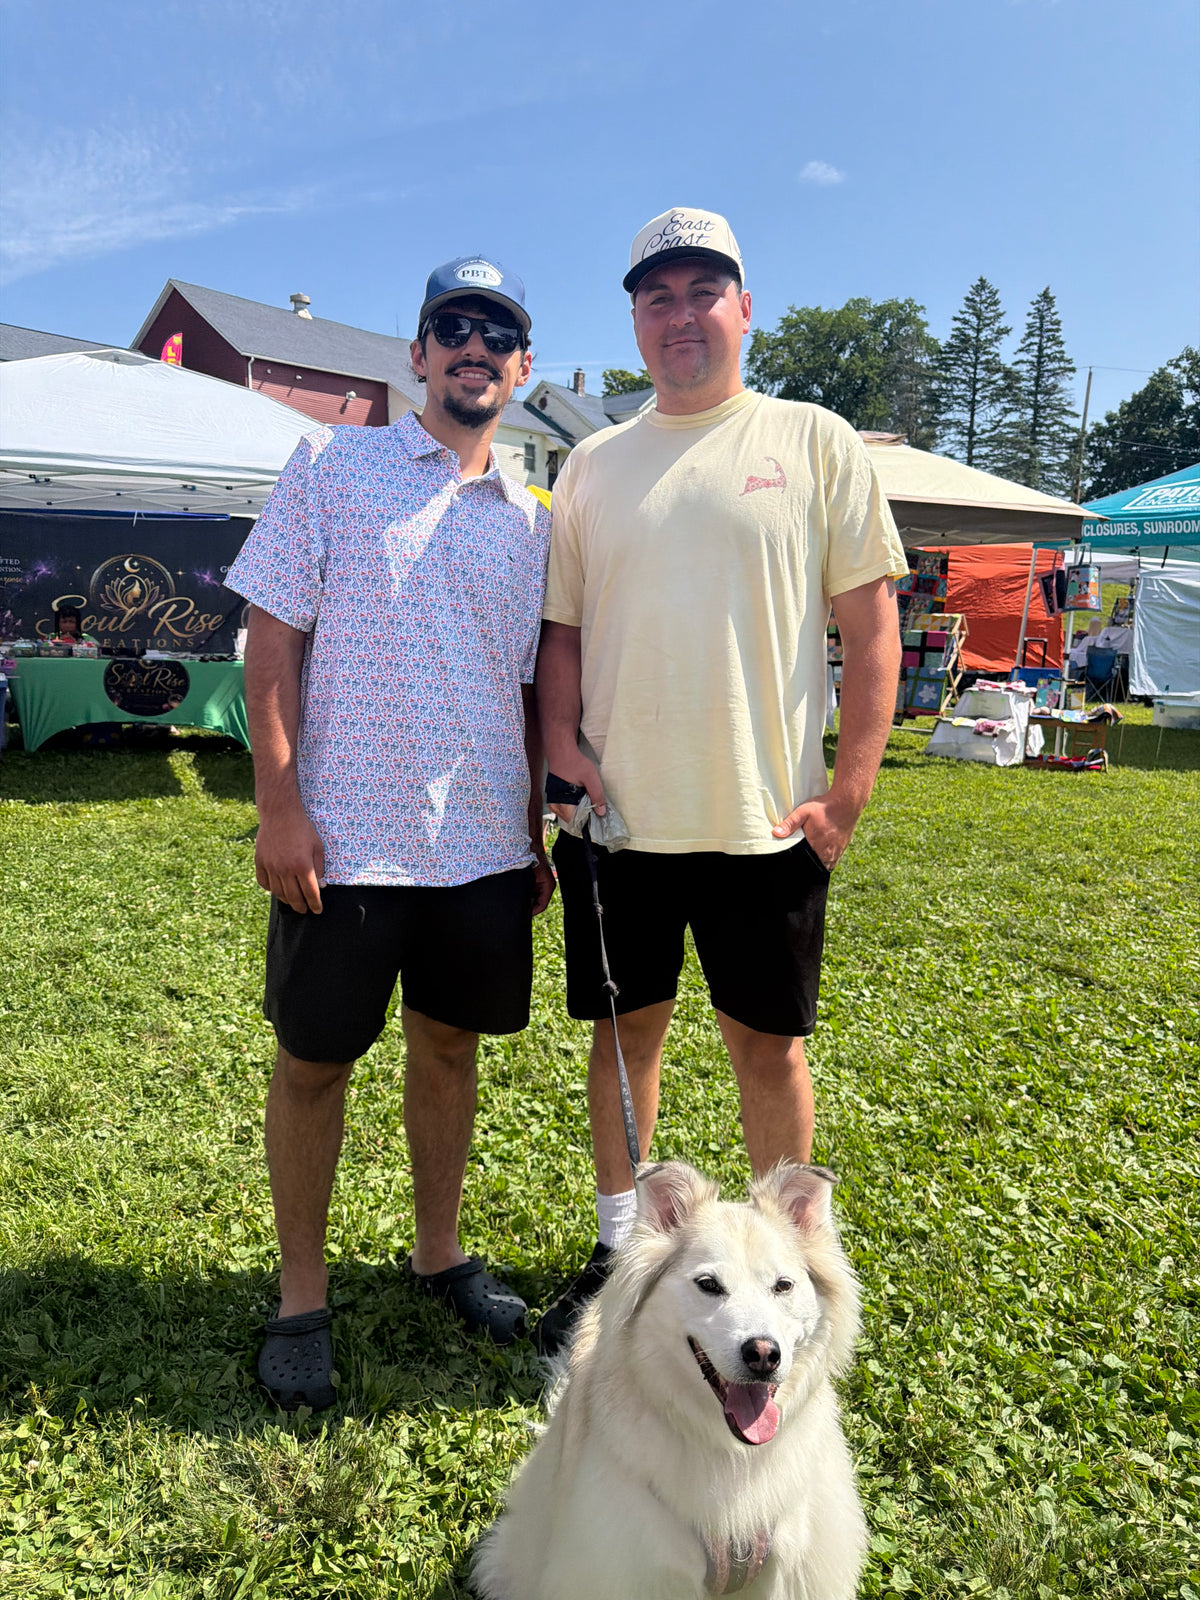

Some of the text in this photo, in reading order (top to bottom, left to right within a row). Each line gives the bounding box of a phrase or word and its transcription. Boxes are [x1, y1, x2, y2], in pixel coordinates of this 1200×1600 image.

[662, 213, 716, 236] East
[641, 232, 712, 261] Coast
[461, 269, 497, 282] PBTS
[147, 596, 223, 638] Rise
[101, 637, 195, 651] EATIONS
[151, 667, 185, 692] Rise
